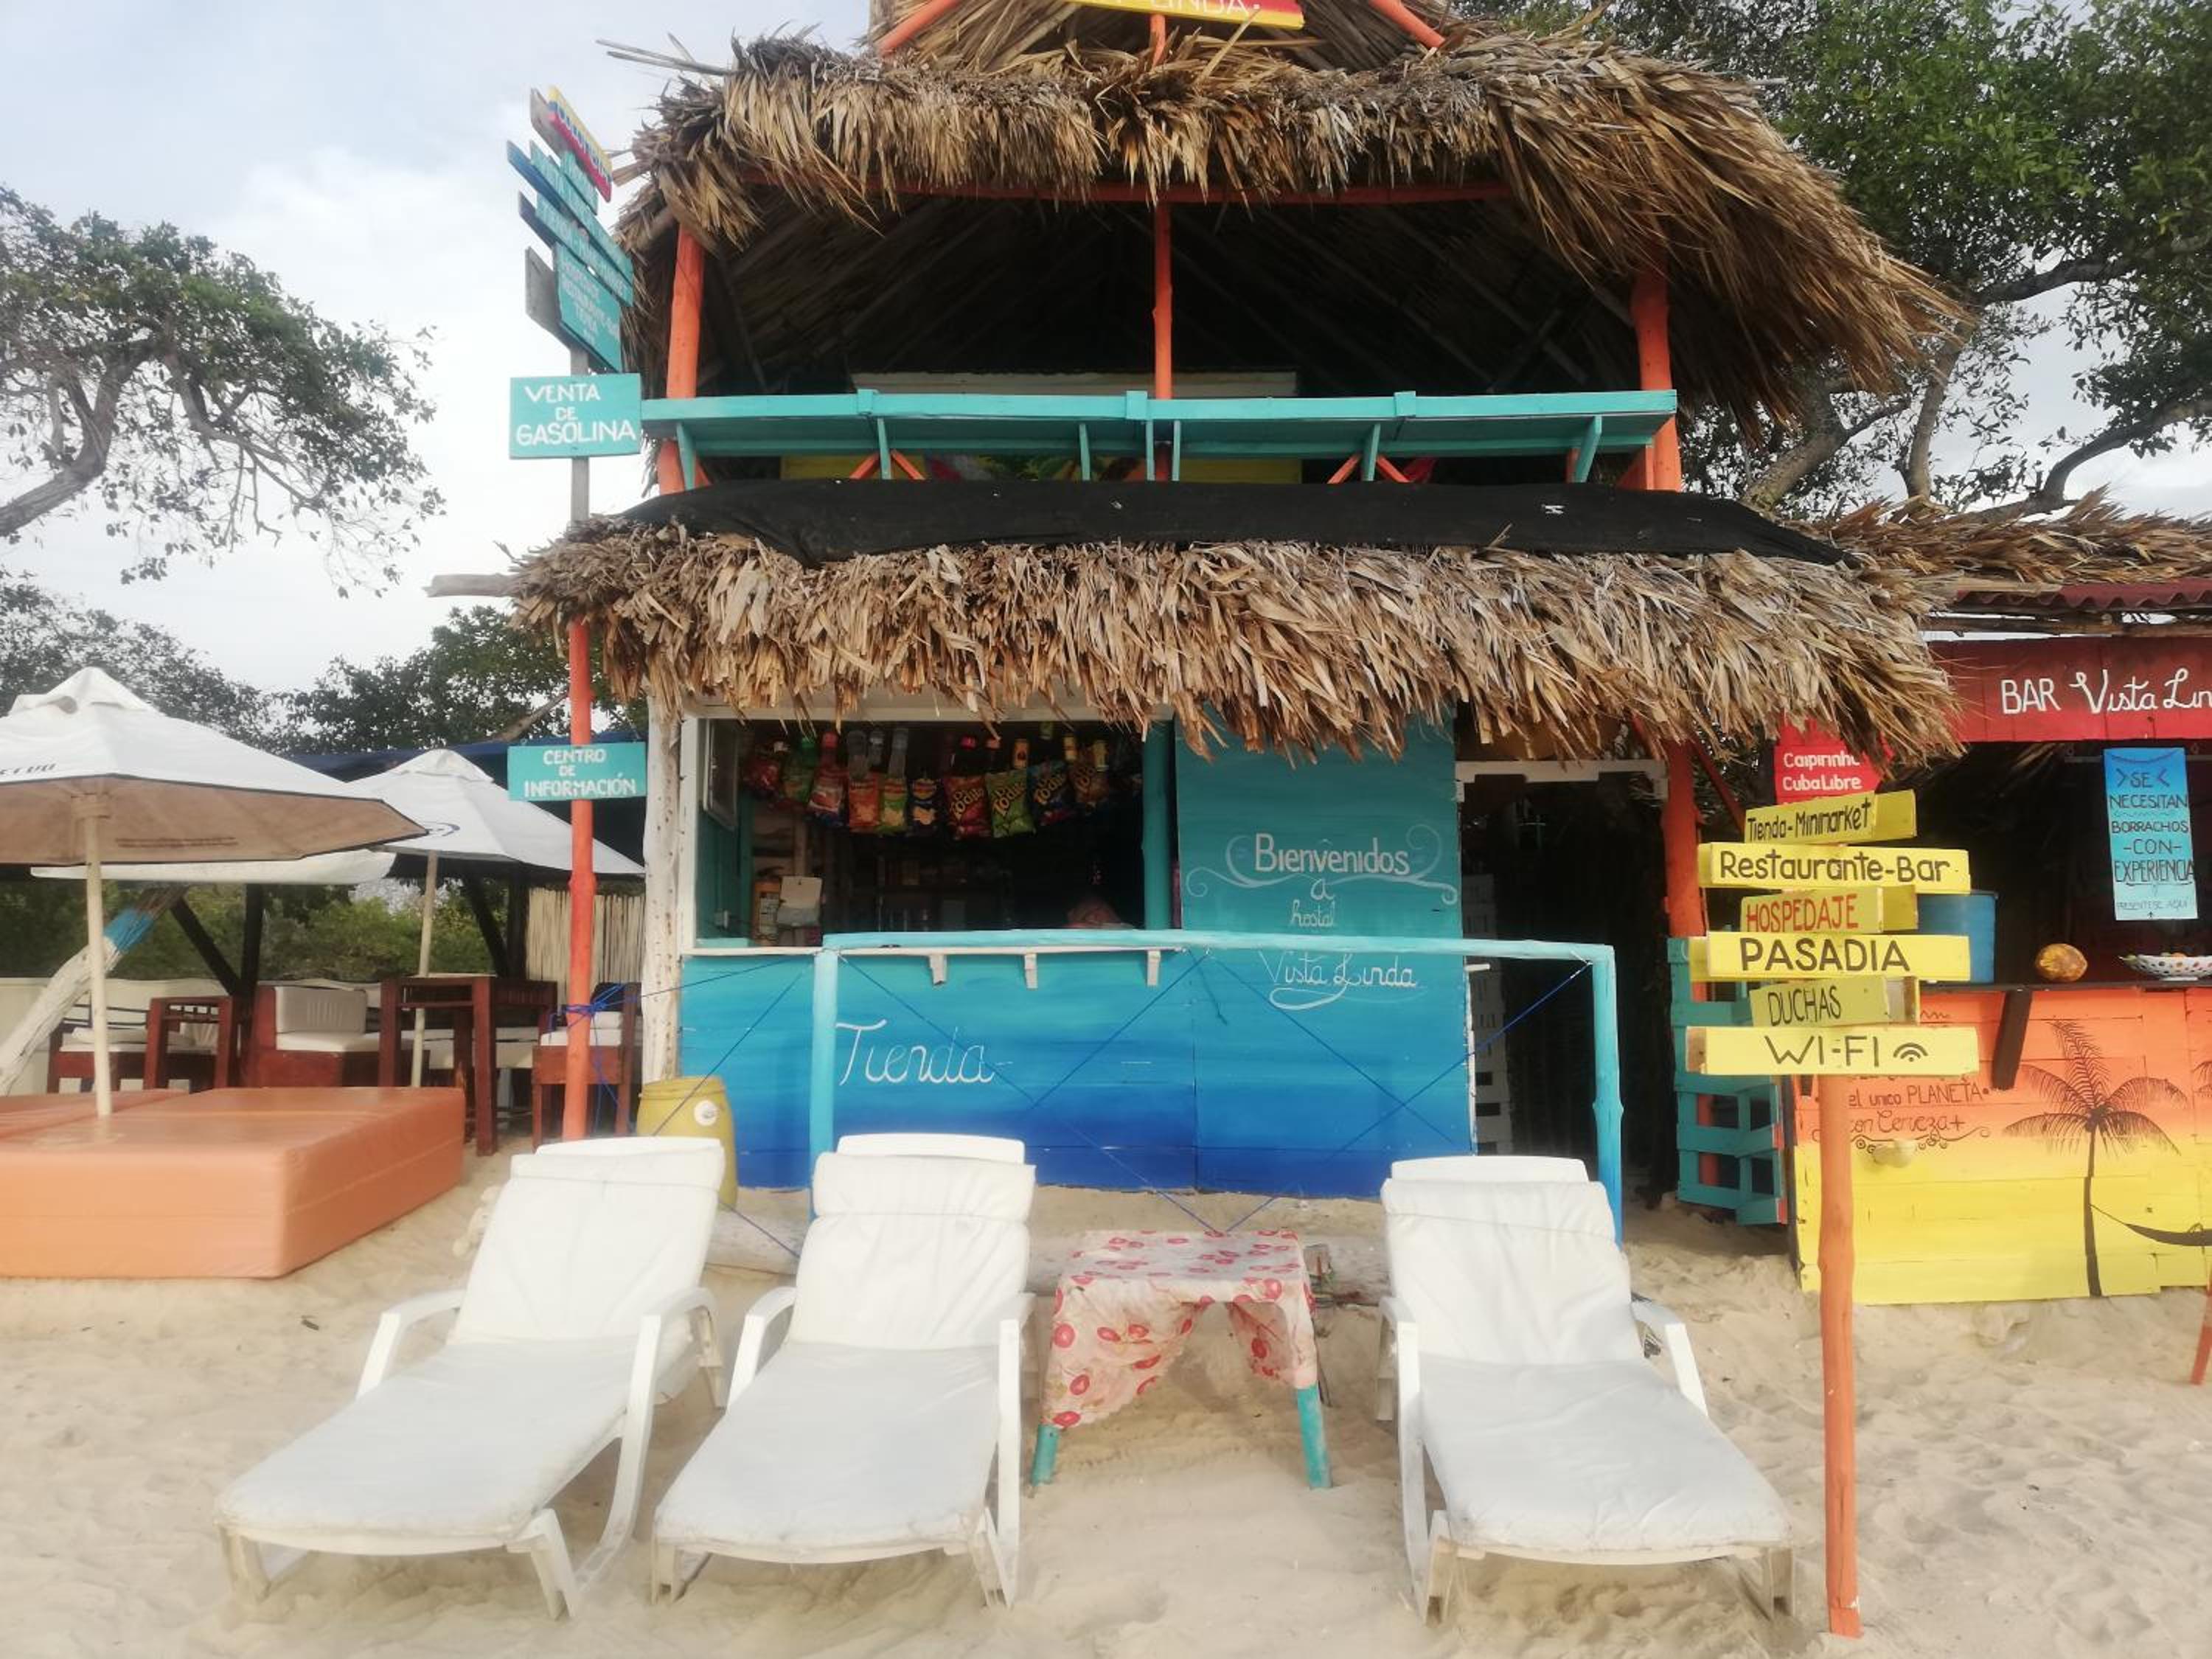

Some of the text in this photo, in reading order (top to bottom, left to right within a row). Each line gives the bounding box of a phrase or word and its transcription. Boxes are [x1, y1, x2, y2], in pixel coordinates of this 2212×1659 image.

[524, 383, 601, 403] VENTA
[555, 406, 579, 421] DE
[516, 420, 637, 446] GASOLINA
[2000, 678, 2062, 714] BAR
[2069, 669, 2159, 714] Vista
[543, 748, 608, 765] CENTRO
[558, 764, 577, 776] DE
[524, 772, 636, 797] INFORMACIÓN
[2110, 794, 2188, 809] NECESITAN
[2112, 821, 2189, 833] BORRACHOS
[1256, 833, 1411, 875] Bienvenidos
[2115, 859, 2195, 883] EXPERIENCIA
[1290, 899, 1335, 928] hostal
[1746, 894, 1859, 931] HOSPEDAJE
[1739, 938, 1910, 972] PASADIA
[1259, 951, 1418, 988] Vista Linda
[1767, 986, 1842, 1027] DUCHAS
[835, 1019, 995, 1085] Tienda
[1764, 1035, 1879, 1067] WI-FI
[1906, 1083, 1983, 1104] PLANETA
